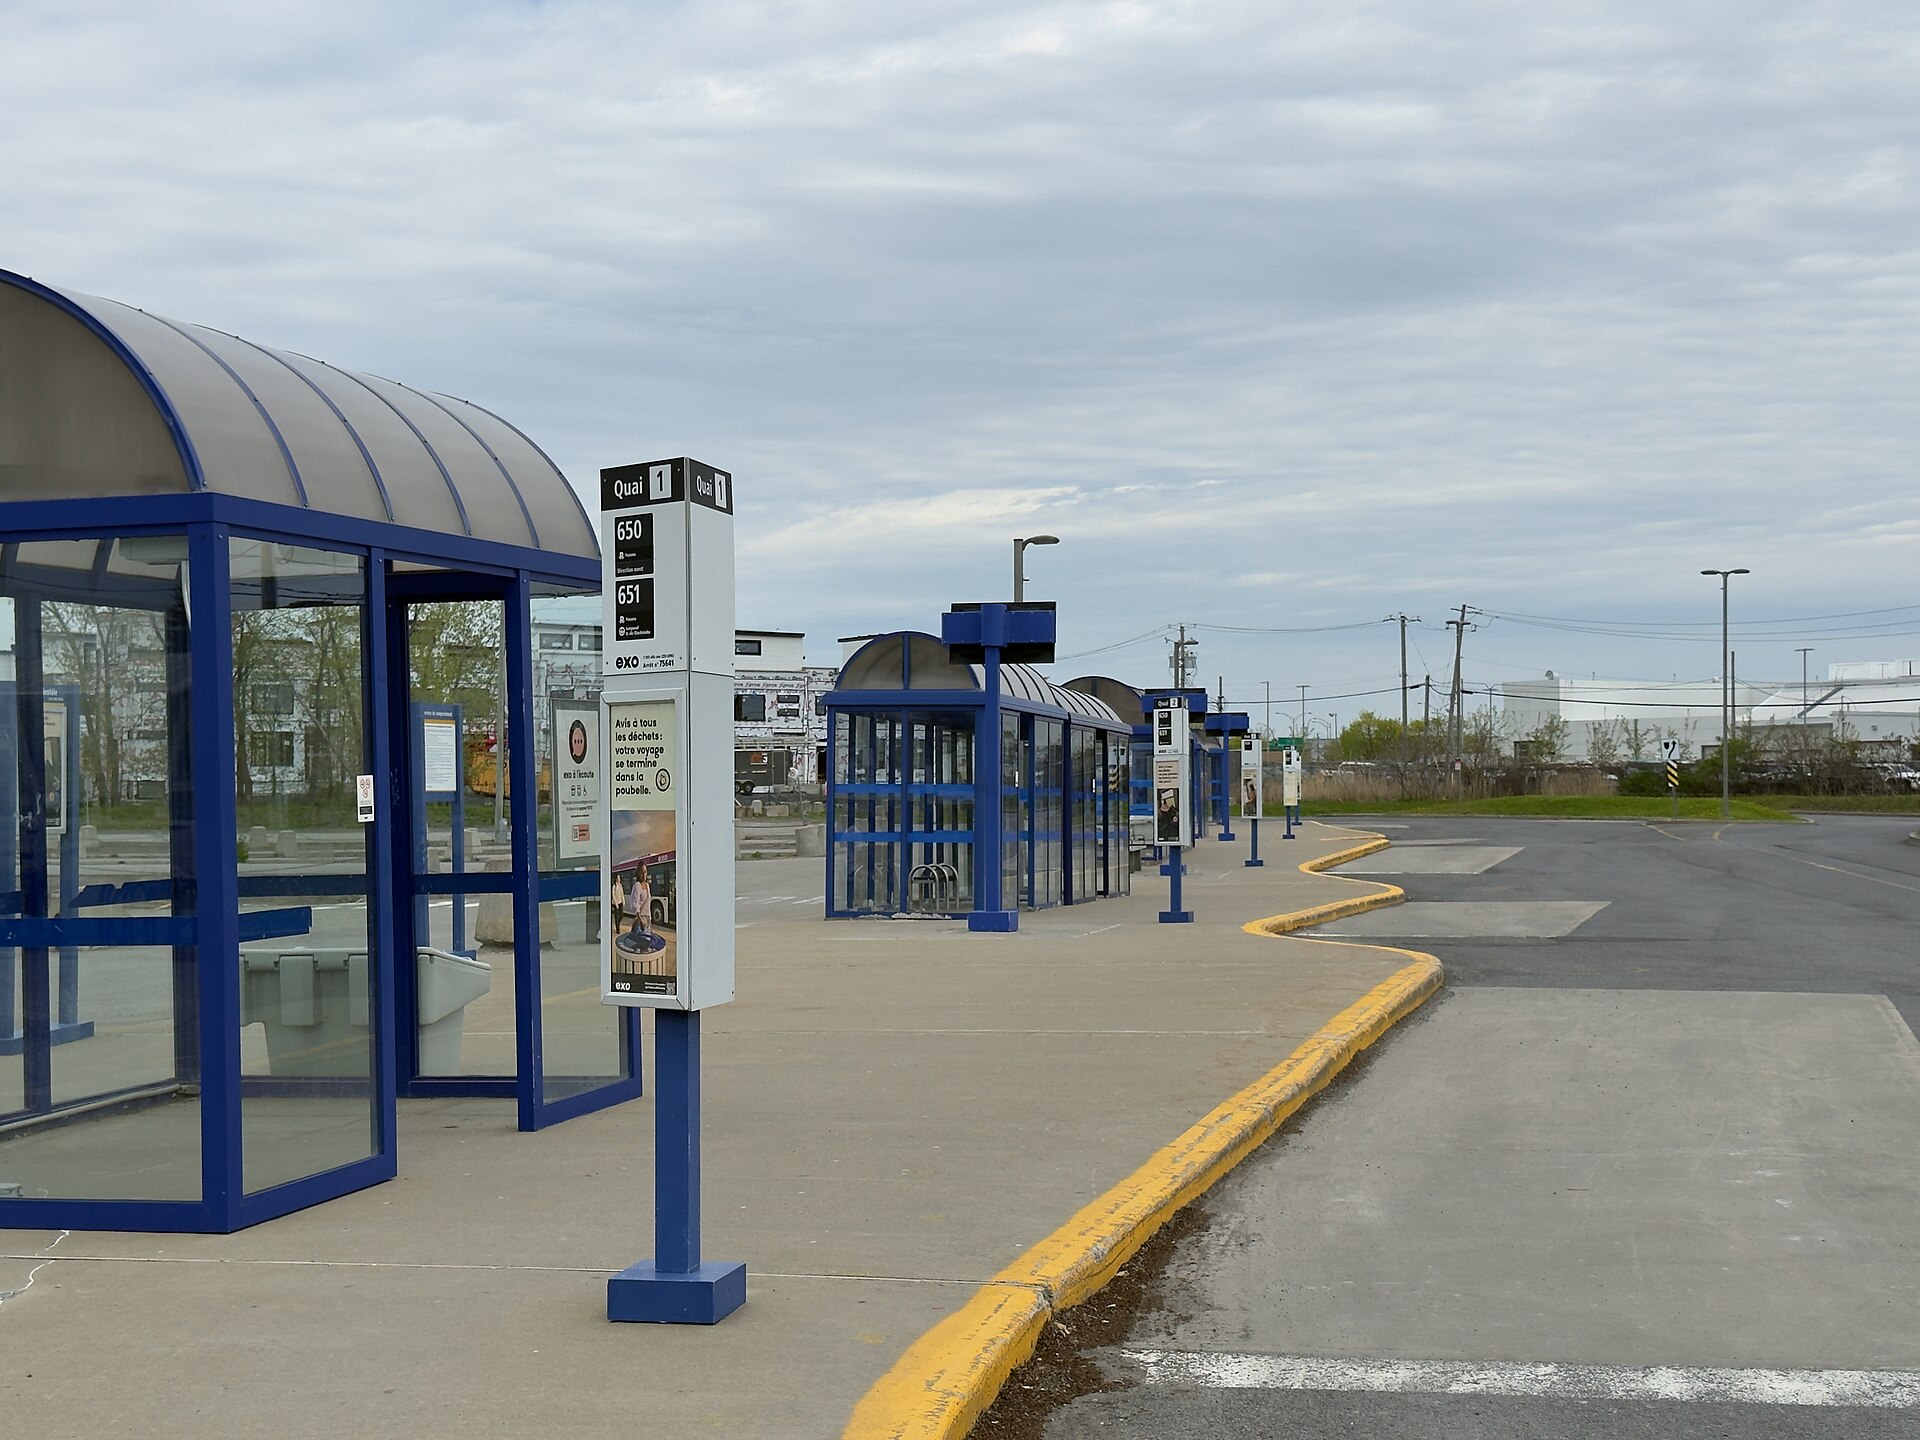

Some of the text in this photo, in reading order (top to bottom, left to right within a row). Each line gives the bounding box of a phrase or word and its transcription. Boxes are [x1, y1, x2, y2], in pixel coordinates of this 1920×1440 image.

[614, 470, 663, 500] Quai 1
[696, 475, 723, 501] Quai 1
[617, 519, 642, 541] 650
[618, 584, 640, 605] 651
[616, 656, 640, 669] exo
[615, 717, 657, 728] Avis à tous
[616, 732, 626, 741] les
[615, 746, 664, 758] votre voyage
[626, 758, 657, 768] termine
[616, 772, 644, 781] dans la
[615, 982, 631, 991] exo
